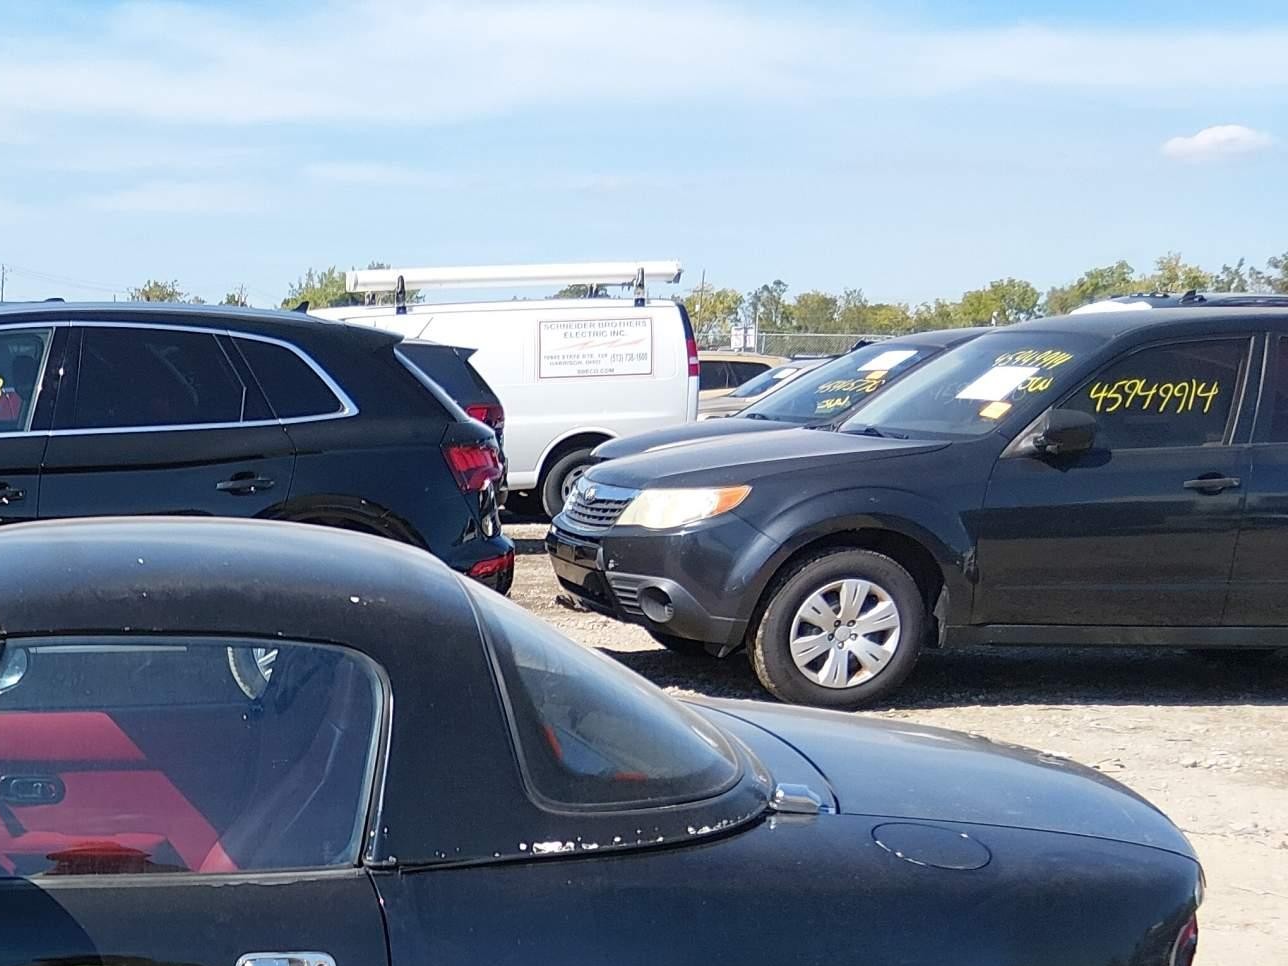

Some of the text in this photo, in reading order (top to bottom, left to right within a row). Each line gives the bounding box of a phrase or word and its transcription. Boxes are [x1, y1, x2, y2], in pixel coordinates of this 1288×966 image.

[544, 320, 647, 330] SCHNEIDER BROTHERS
[563, 330, 608, 338] ELECTRIC
[1089, 378, 1219, 414] 45949914
